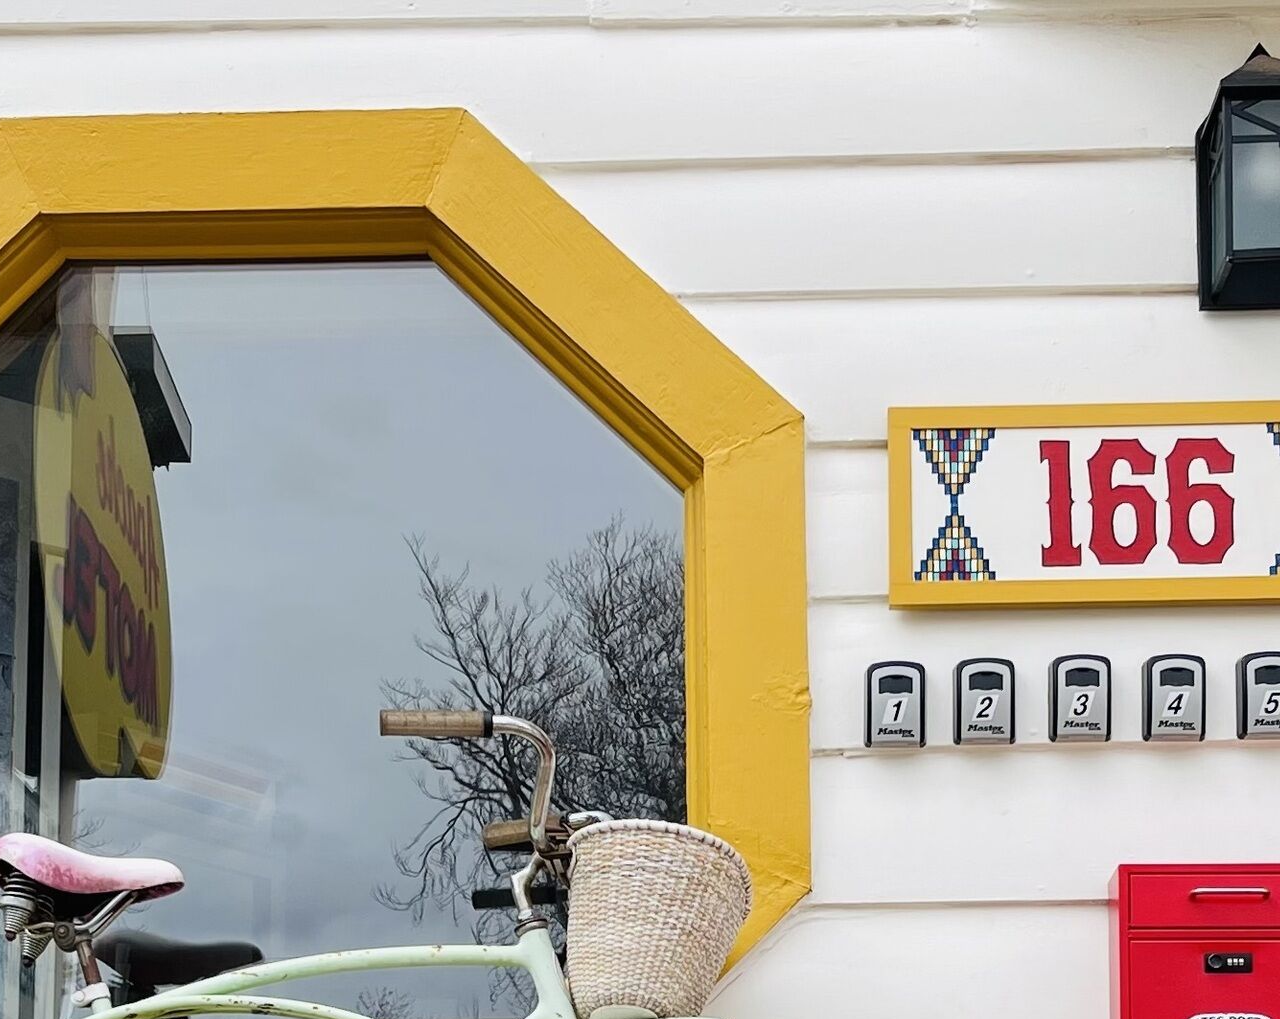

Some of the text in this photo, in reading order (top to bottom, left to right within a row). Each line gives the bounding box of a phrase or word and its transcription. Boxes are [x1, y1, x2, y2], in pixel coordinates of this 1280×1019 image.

[1039, 437, 1235, 567] 166
[892, 700, 903, 722] 1
[976, 696, 993, 719] 2
[1073, 693, 1089, 716] 3
[1167, 693, 1184, 715] 4
